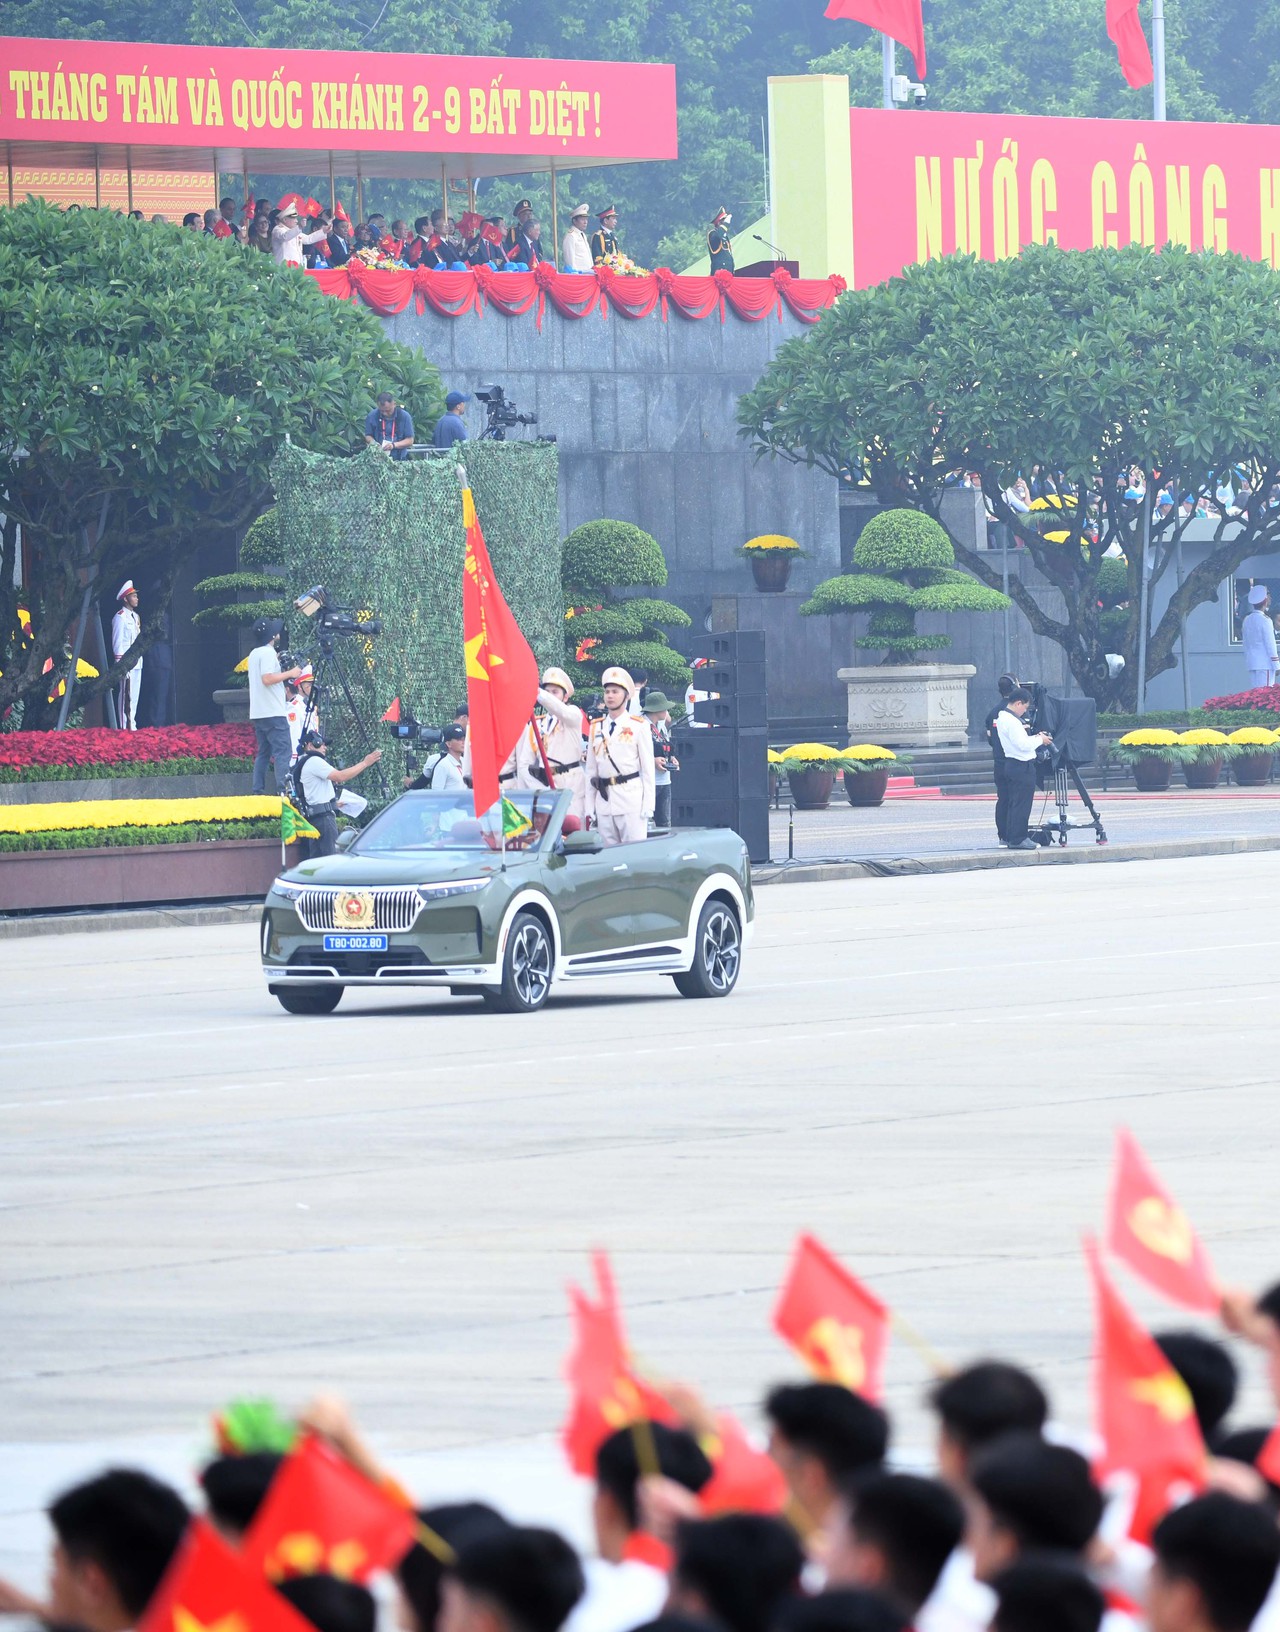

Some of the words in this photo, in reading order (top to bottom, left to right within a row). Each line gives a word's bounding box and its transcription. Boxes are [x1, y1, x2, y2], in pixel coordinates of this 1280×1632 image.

[9, 61, 108, 122] THÁNG
[116, 64, 179, 125] TÁM
[186, 68, 224, 127] VÀ
[231, 66, 303, 131] QUỐC
[311, 73, 405, 132] KHÁNH
[413, 86, 461, 134] 2-9
[469, 73, 521, 136] BẤT
[914, 137, 1059, 268] NƯỚC
[1091, 142, 1228, 257] CÔNG
